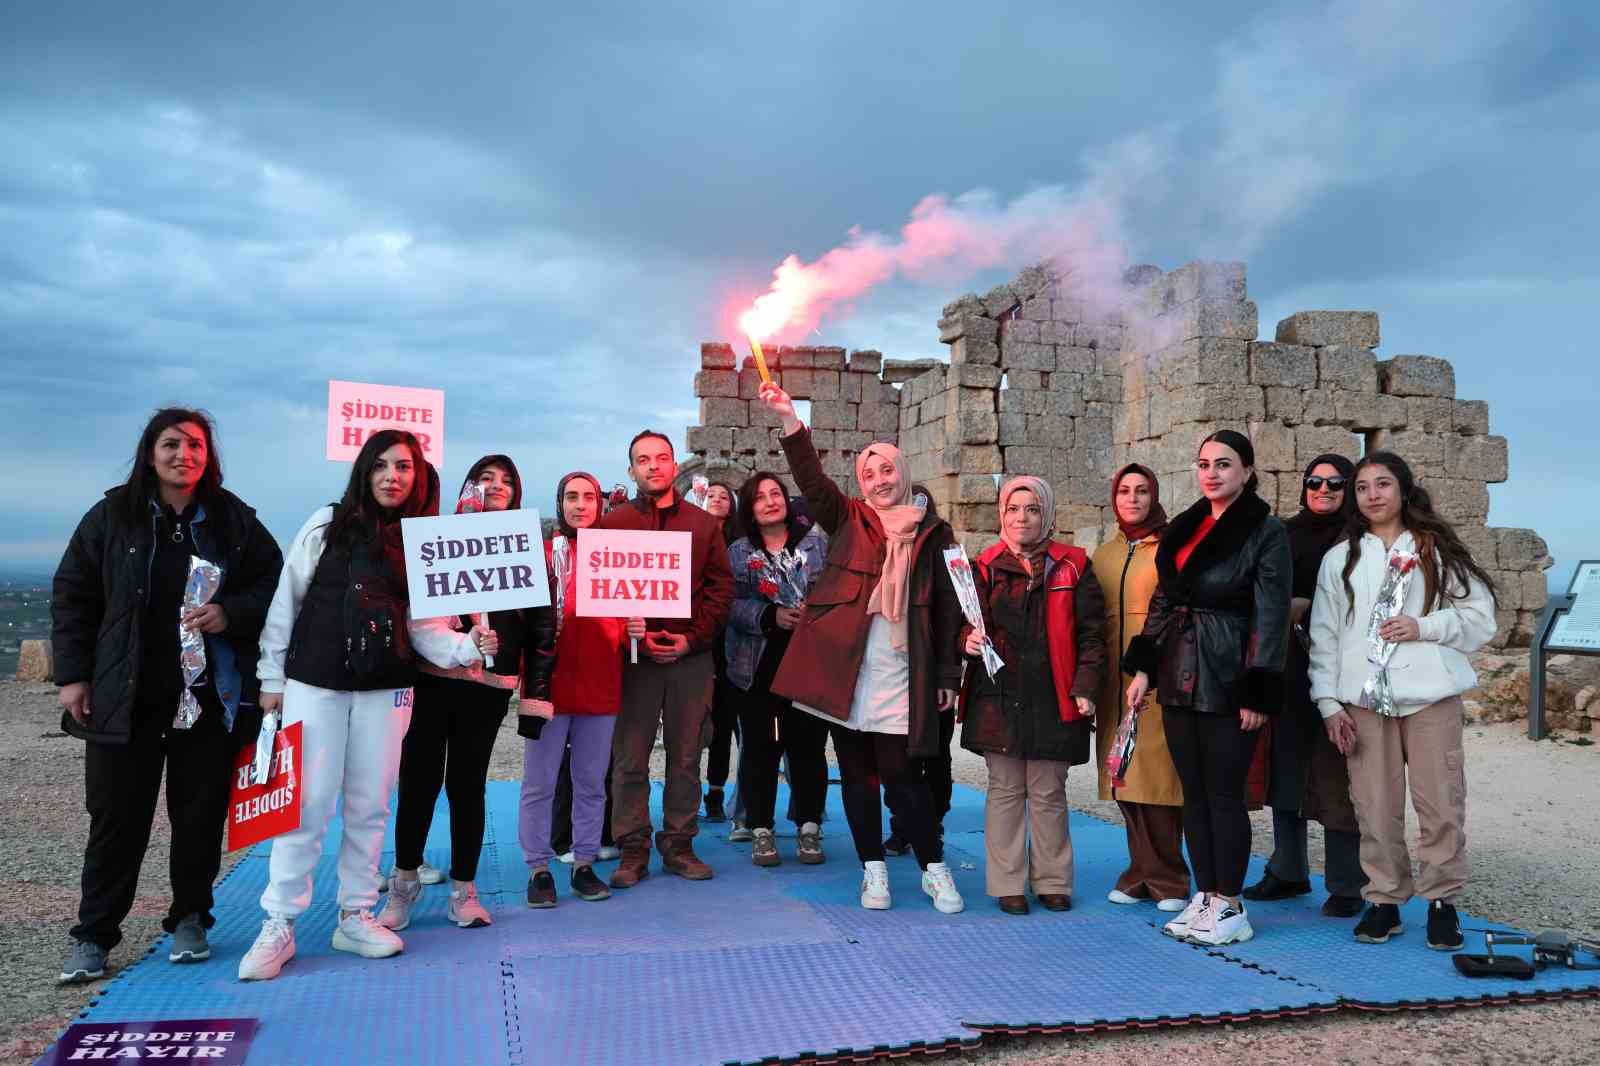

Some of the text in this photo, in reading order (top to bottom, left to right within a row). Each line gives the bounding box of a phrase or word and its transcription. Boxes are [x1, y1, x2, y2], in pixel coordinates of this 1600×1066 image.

[341, 398, 433, 424] ŞİDDETE
[420, 534, 530, 567] ŞİDDETE
[589, 546, 681, 573] ŞİDDETE
[424, 565, 535, 597] HAYIR
[590, 578, 680, 601] HAYIR
[79, 1030, 236, 1046] ŞİDDETE
[67, 1045, 228, 1060] HAYIR
